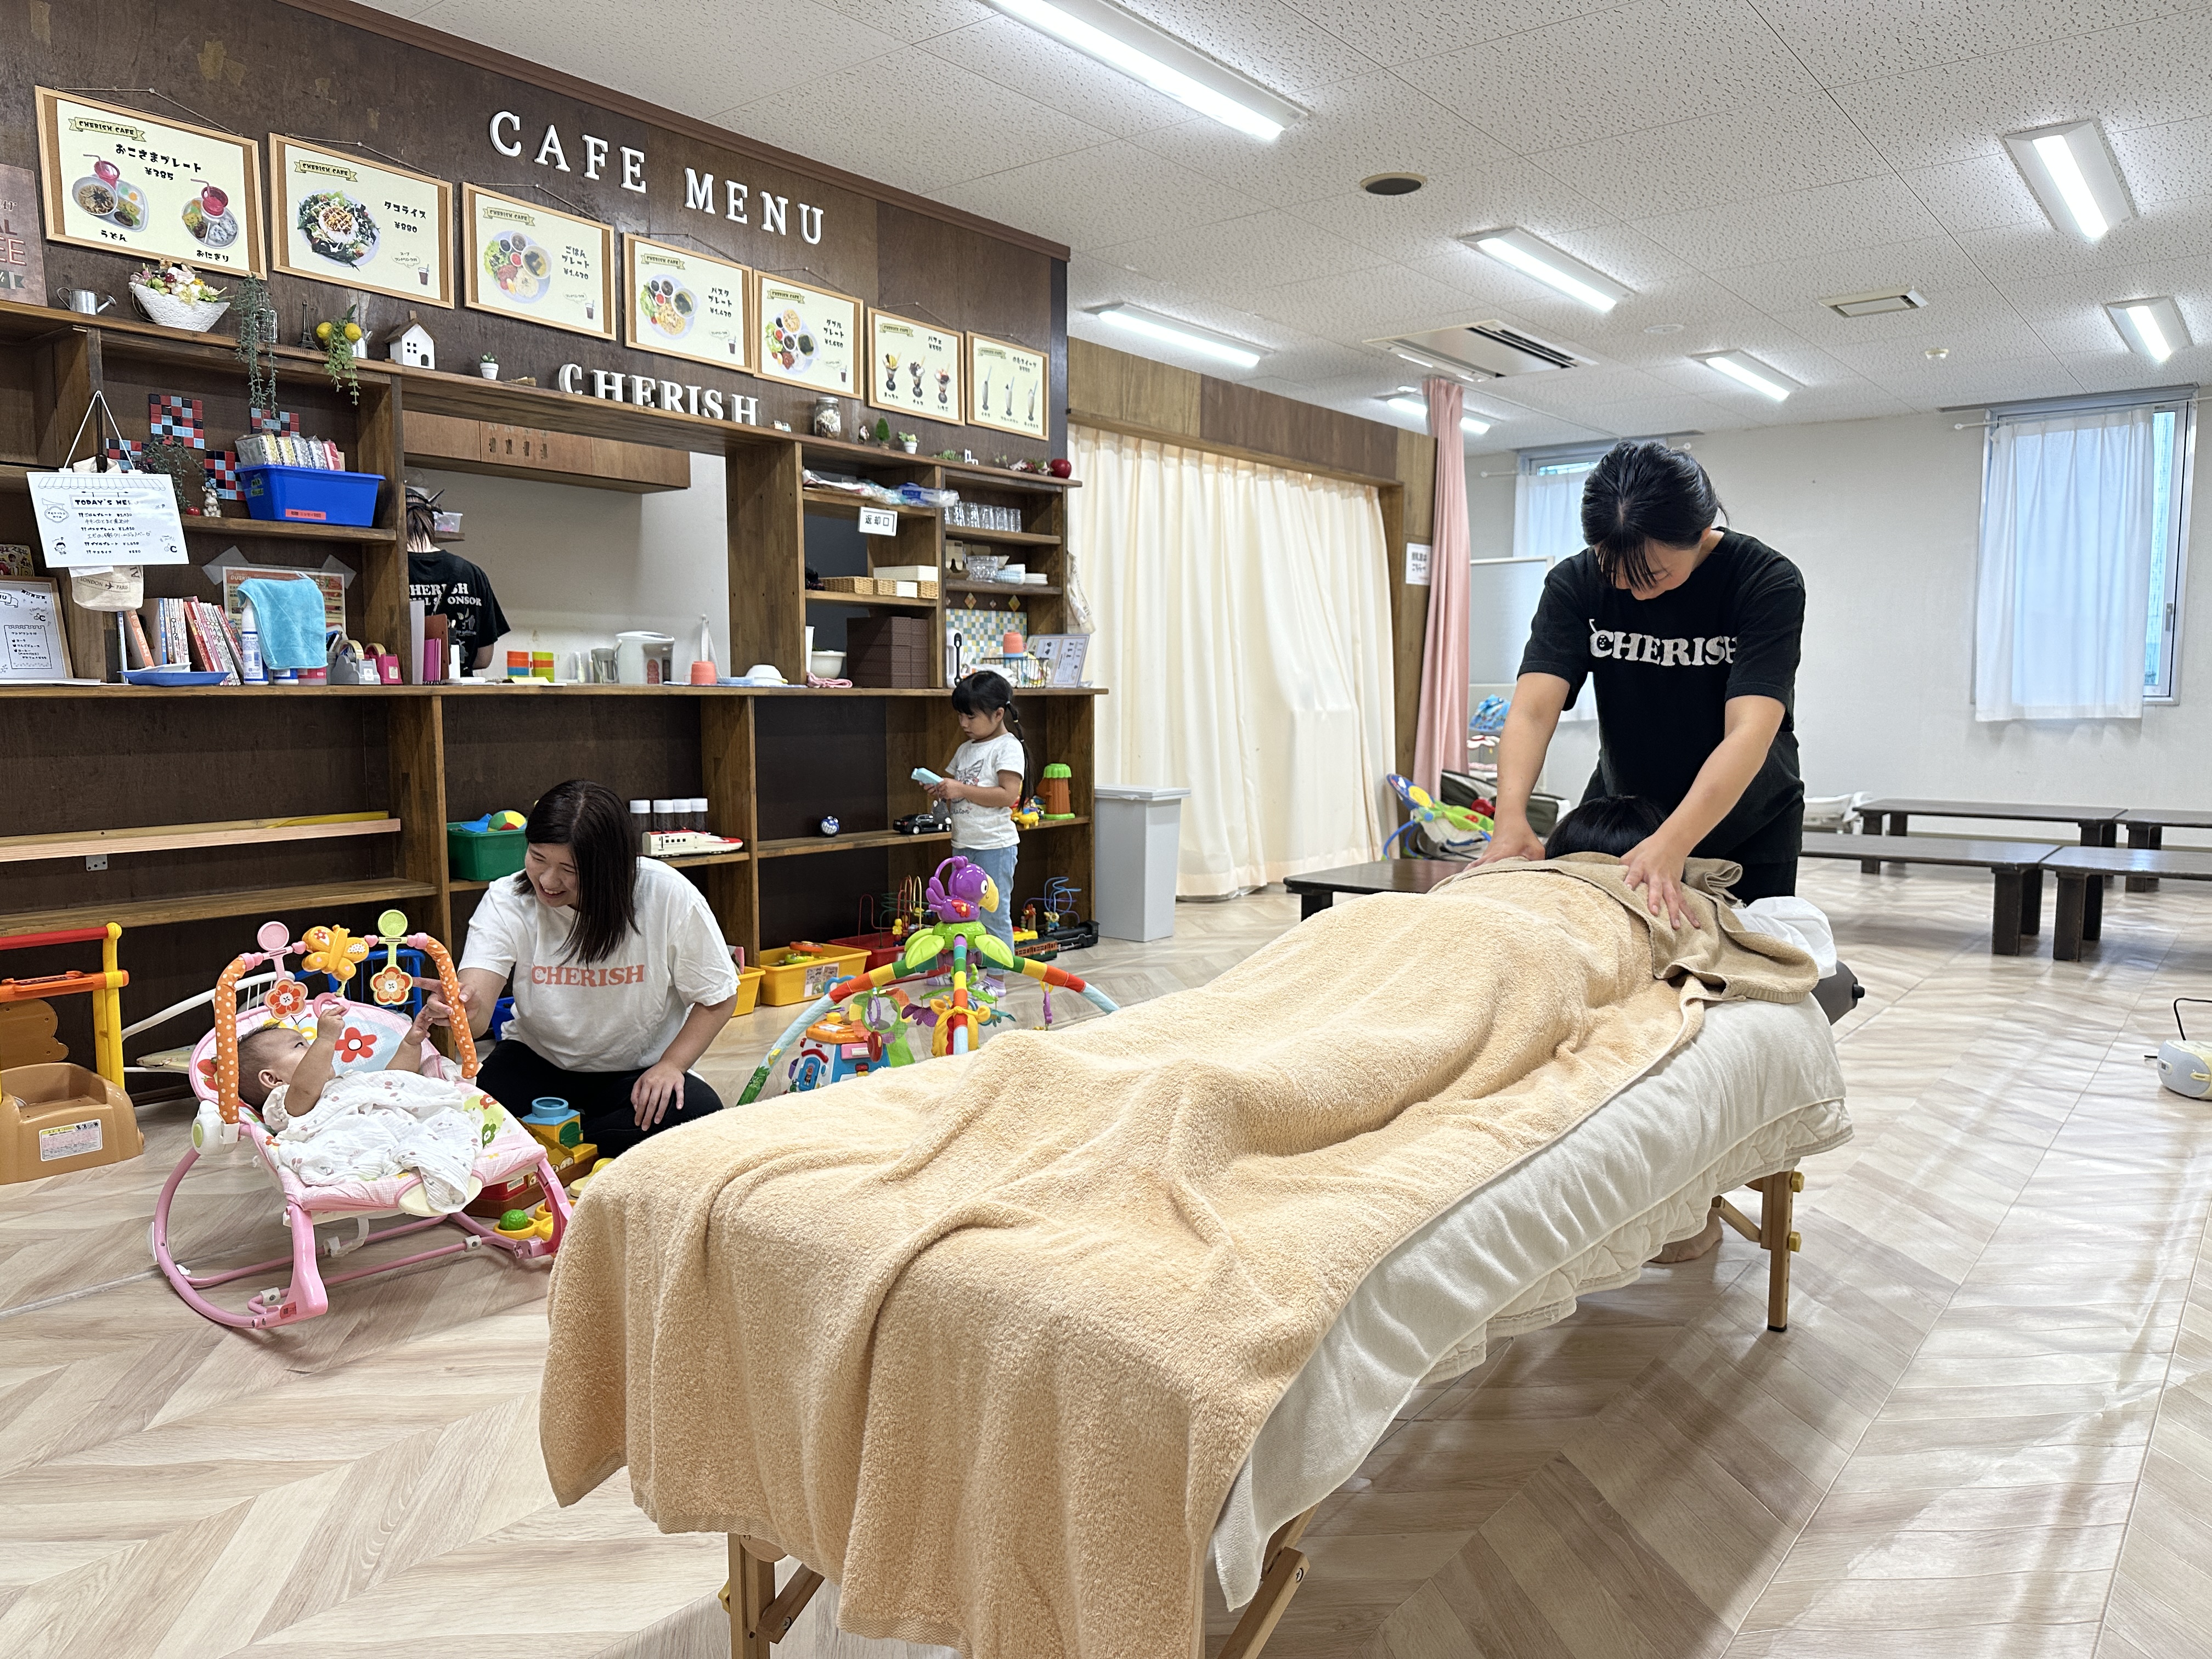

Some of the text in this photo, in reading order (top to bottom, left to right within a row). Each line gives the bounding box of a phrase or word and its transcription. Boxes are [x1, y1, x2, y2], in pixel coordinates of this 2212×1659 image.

[79, 121, 112, 132] CHERISH
[116, 144, 201, 172] おこさまプレート
[145, 167, 173, 180] ¥385
[302, 163, 330, 172] CHERISH
[490, 110, 823, 245] CAFE MENU
[384, 201, 426, 219] タコライス
[490, 210, 512, 218] CHERISH
[394, 221, 417, 233] ¥880
[100, 229, 128, 242] うどん
[196, 250, 229, 262] おにぎり
[566, 246, 586, 258] ごはん
[562, 255, 590, 269] プレート
[711, 287, 729, 297] パスタ
[708, 295, 732, 307] プレート
[823, 327, 844, 338] プレート
[558, 364, 759, 427] CHERISH
[865, 515, 890, 527] 返却口
[129, 567, 140, 578] AI
[80, 577, 103, 587] LONDON
[532, 964, 645, 988] CHERISH
